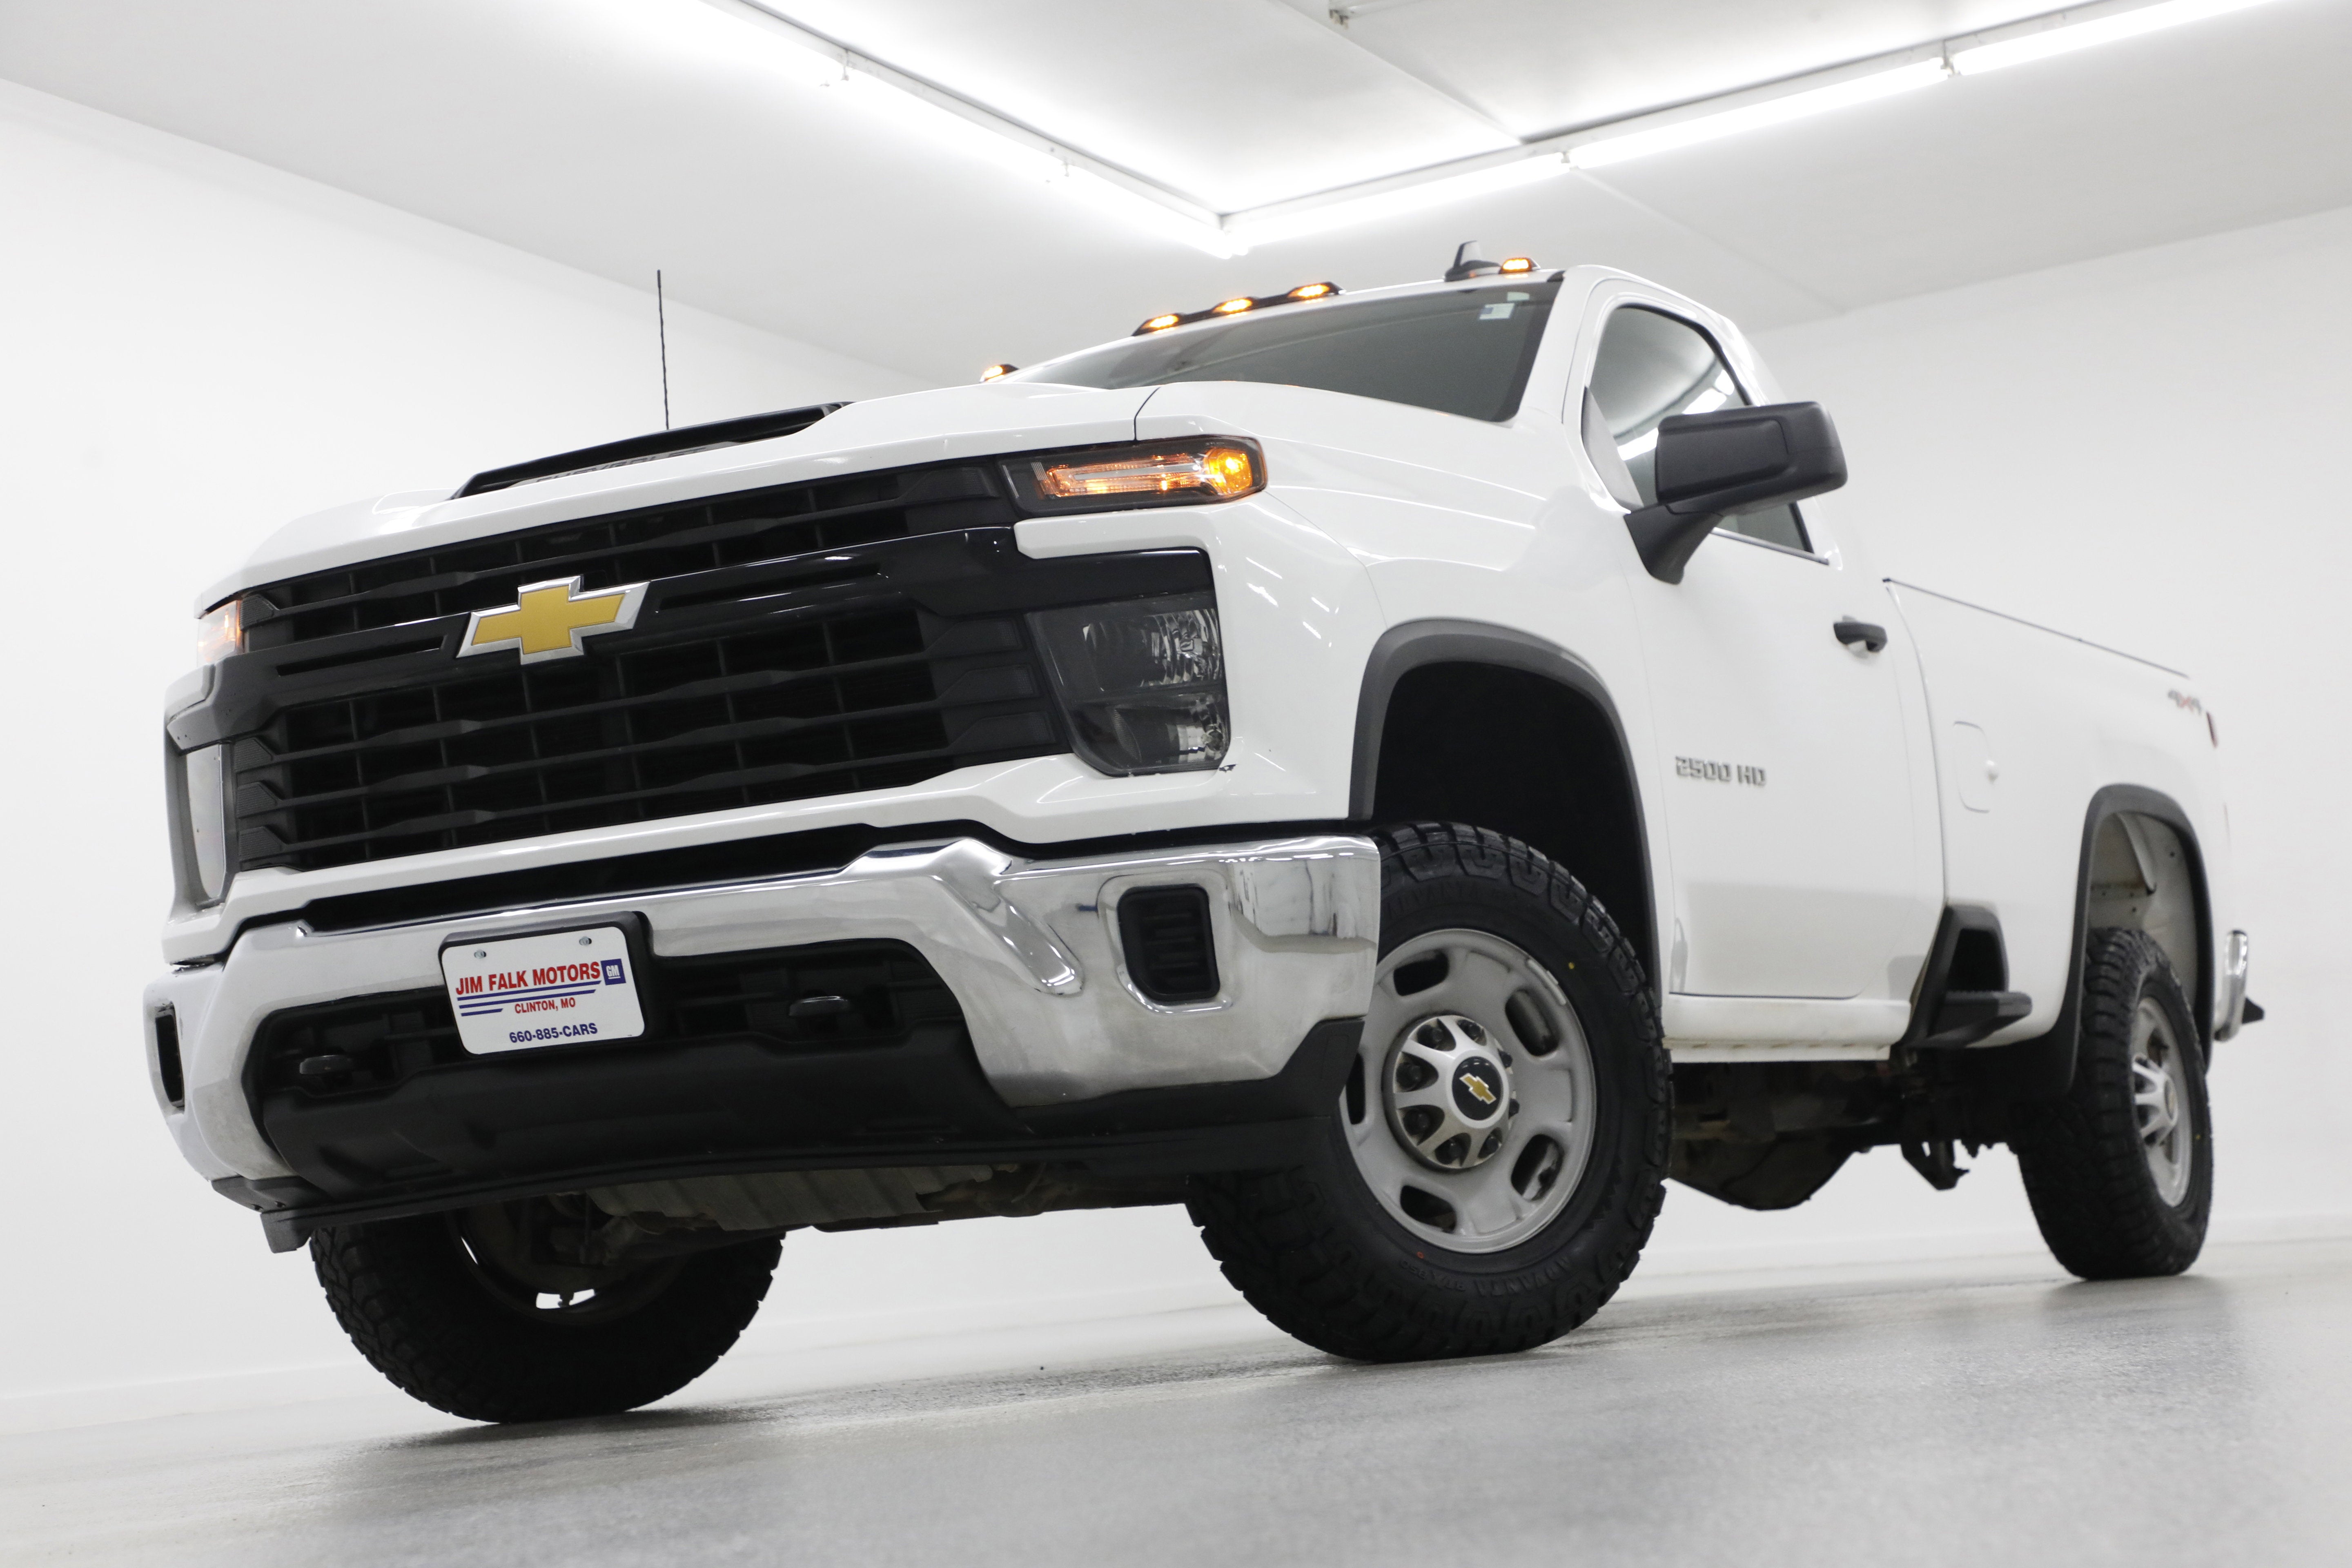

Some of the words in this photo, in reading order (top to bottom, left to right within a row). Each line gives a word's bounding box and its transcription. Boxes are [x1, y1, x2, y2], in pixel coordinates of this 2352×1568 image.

[1675, 755, 1731, 782] 2500
[1737, 764, 1766, 787] HD
[455, 976, 483, 995] JIM
[488, 970, 528, 991] FALK
[532, 961, 601, 986] MOTORS
[606, 964, 620, 977] GM
[514, 999, 559, 1014] CLINTON,
[561, 997, 576, 1008] MO
[509, 1022, 598, 1043] 660-885-CARS
